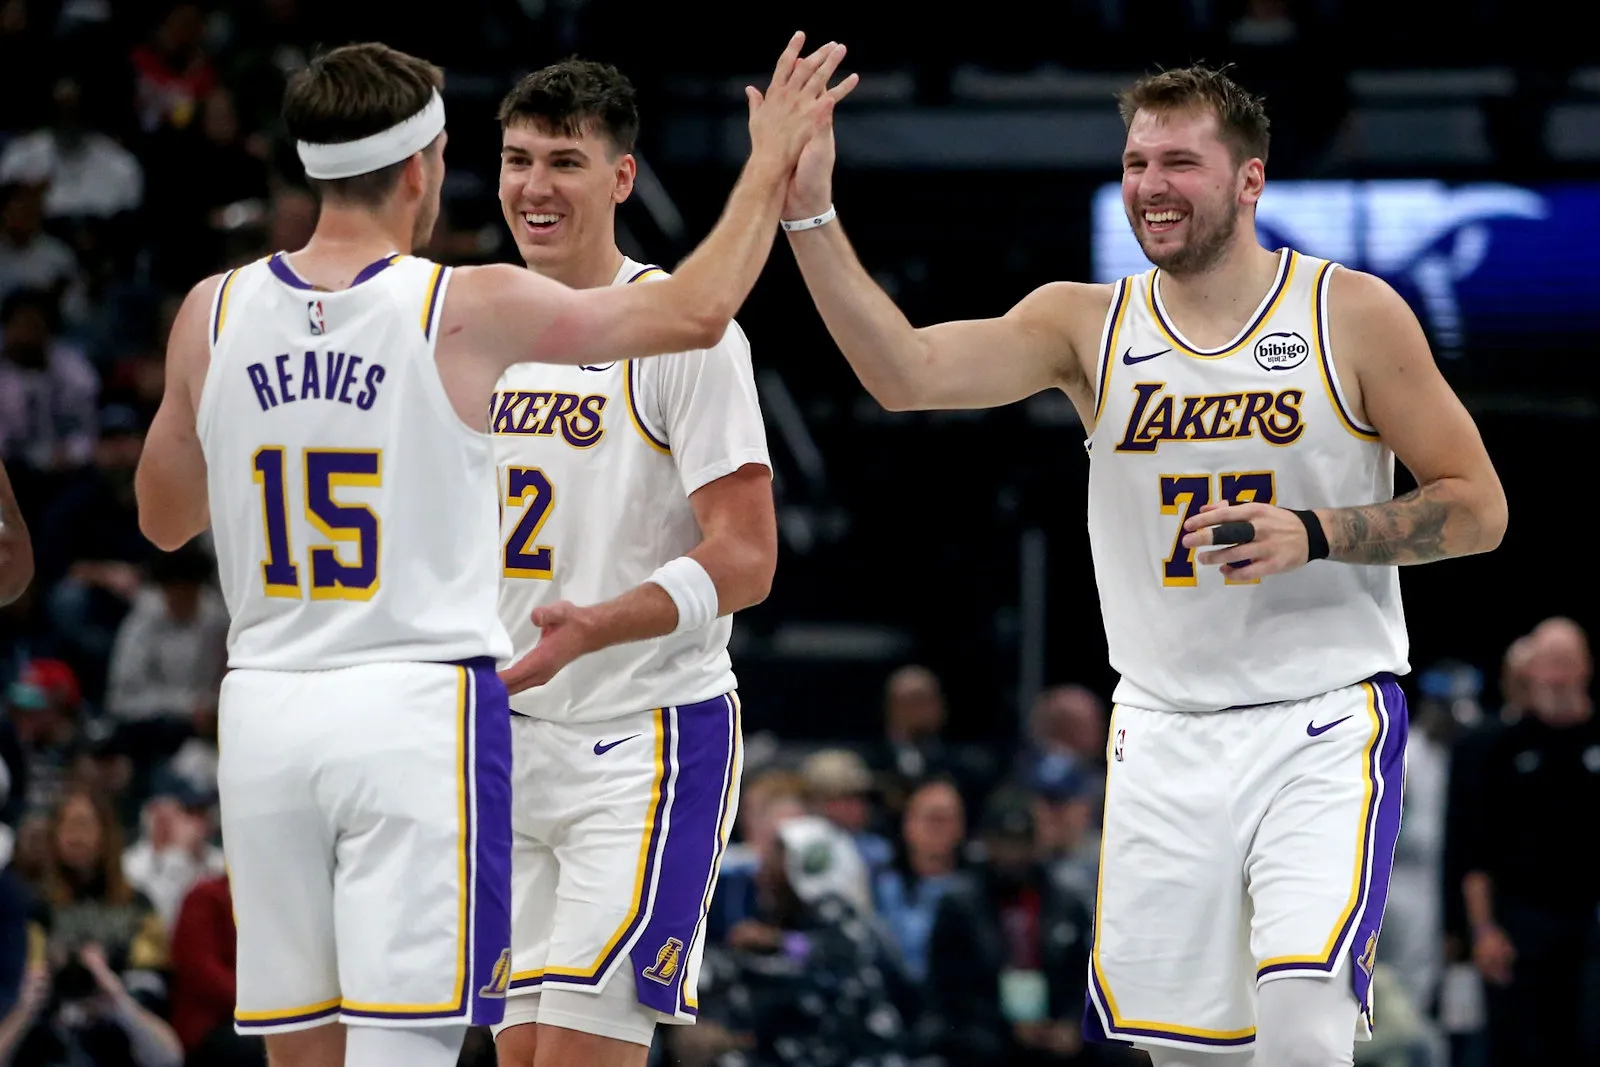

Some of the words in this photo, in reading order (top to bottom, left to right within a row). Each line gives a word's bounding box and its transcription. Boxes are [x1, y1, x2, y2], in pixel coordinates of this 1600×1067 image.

[246, 351, 386, 412] REAVES
[1259, 342, 1305, 358] bibigo
[1114, 381, 1305, 454] LAKERS
[251, 444, 382, 601] 15
[497, 465, 555, 580] 2
[1159, 470, 1277, 587] 77
